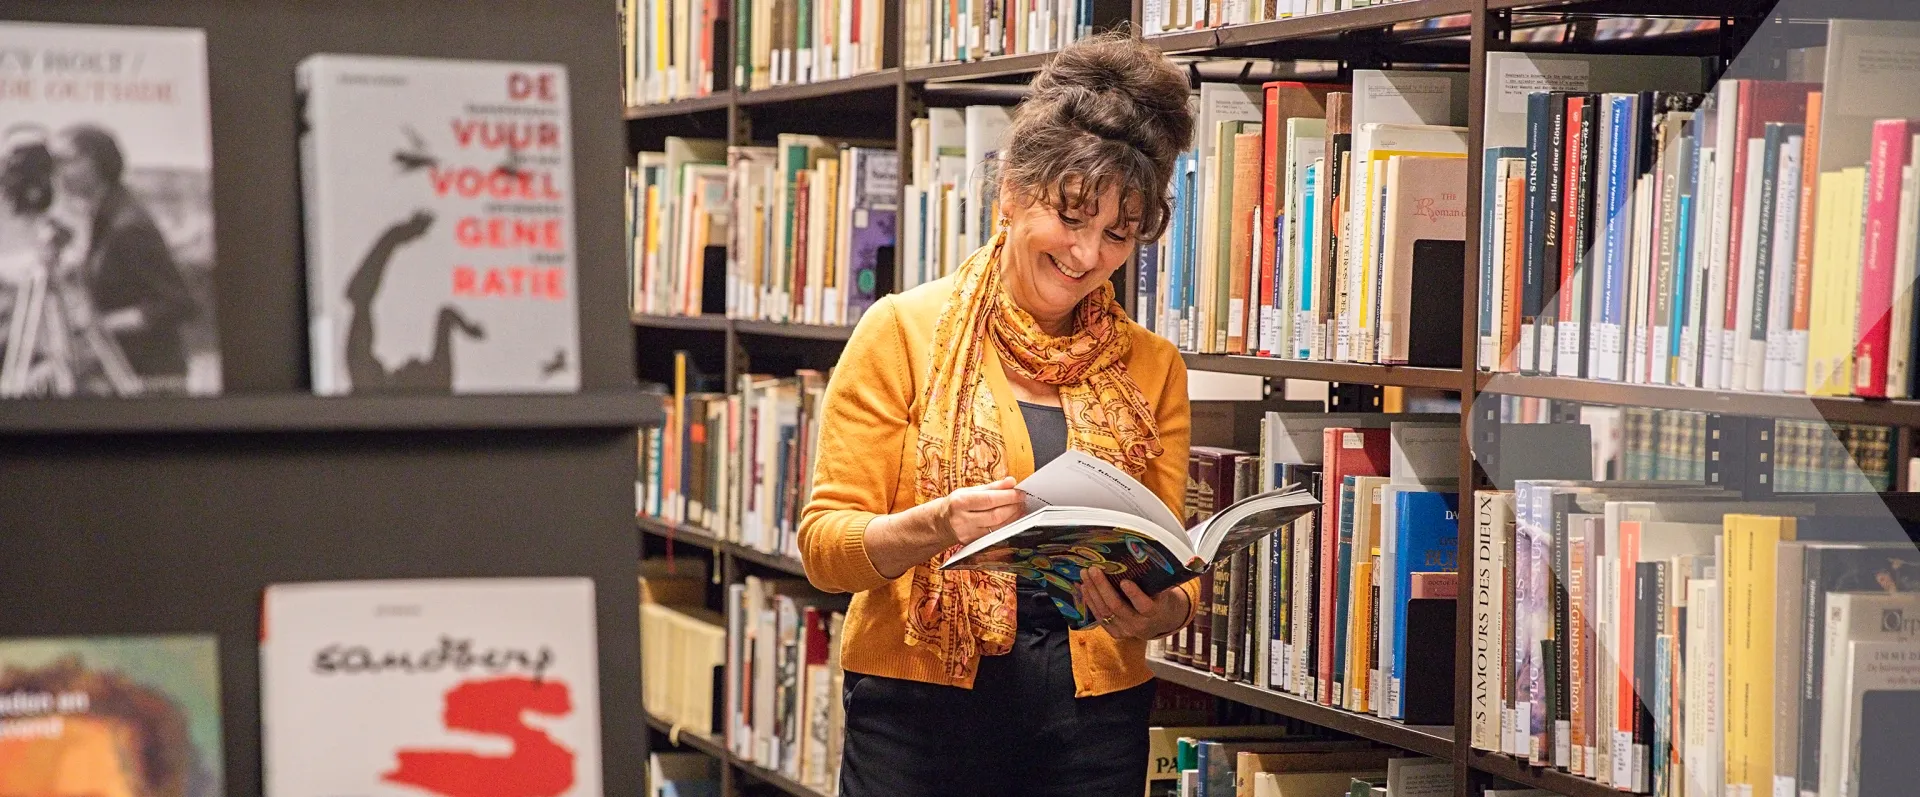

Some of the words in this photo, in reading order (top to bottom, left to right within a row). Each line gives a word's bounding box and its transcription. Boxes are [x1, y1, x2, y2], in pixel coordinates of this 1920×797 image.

[508, 72, 557, 101] DE
[452, 120, 560, 149] VUUR
[1553, 114, 1562, 146] Göttin
[1571, 133, 1580, 163] Venus
[1612, 125, 1620, 174] Iconography
[429, 167, 561, 199] VOGEL
[1265, 155, 1276, 187] folie
[1530, 152, 1538, 193] VENUS
[1612, 176, 1616, 185] of
[1265, 191, 1273, 207] la
[1441, 193, 1457, 201] THE
[1550, 174, 1558, 203] Bilder
[1569, 166, 1577, 218] ontsluierd
[1662, 174, 1676, 223] Cupid
[1264, 210, 1273, 230] de
[1413, 197, 1460, 222] Roman
[456, 217, 563, 249] GENE
[1547, 211, 1557, 247] Venus
[1660, 226, 1671, 256] and
[452, 268, 567, 301] RATIE
[1658, 261, 1670, 311] Psyche
[1516, 488, 1527, 538] ARTS
[1479, 496, 1492, 563] DIEUX
[1294, 538, 1302, 584] Shakespeare's
[1246, 562, 1254, 622] MACBETH
[1478, 568, 1489, 607] DES
[1571, 567, 1583, 593] THE
[1571, 596, 1582, 655] LEGENDS
[1476, 612, 1489, 709] AMOURS
[1571, 678, 1582, 714] TROY
